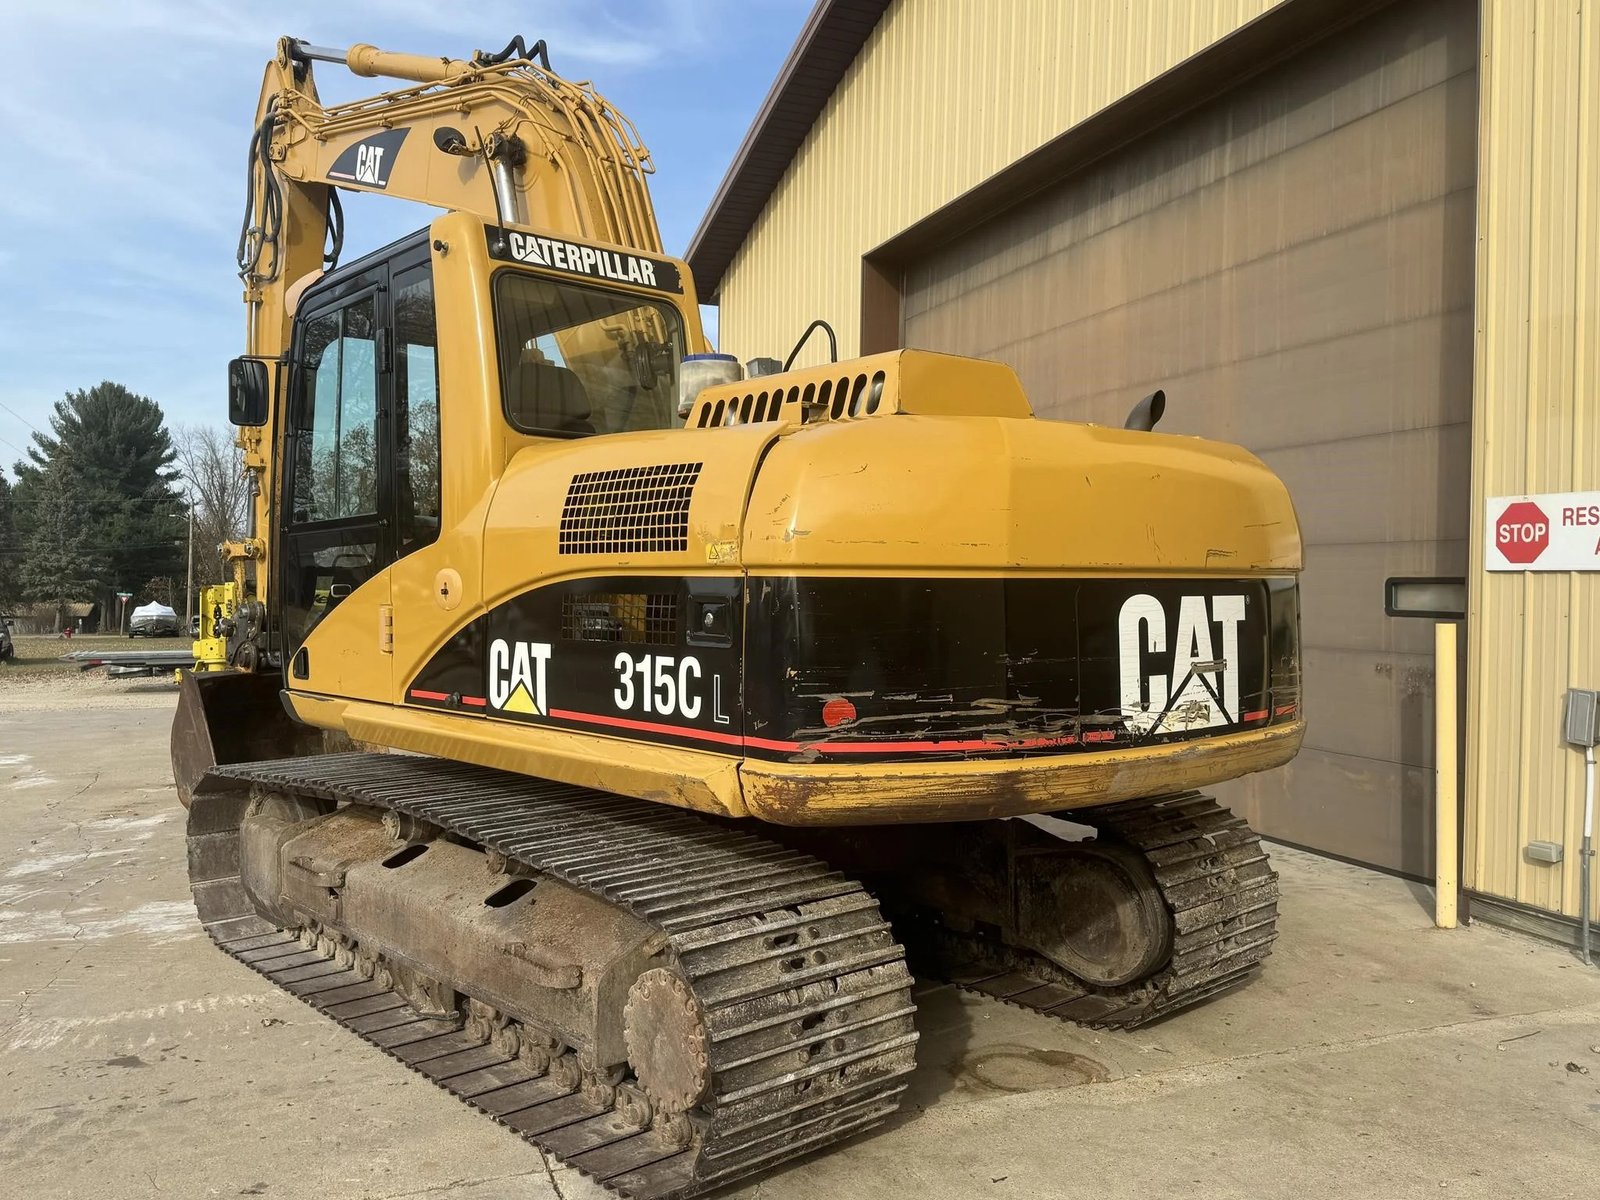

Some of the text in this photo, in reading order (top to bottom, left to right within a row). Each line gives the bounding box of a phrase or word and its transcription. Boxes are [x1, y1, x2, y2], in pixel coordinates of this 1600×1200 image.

[355, 144, 384, 184] CAT
[508, 232, 657, 287] CATERPILLAR
[1499, 523, 1546, 543] STOP
[489, 638, 552, 717] CAT
[614, 652, 730, 725] 315C L
[1118, 593, 1246, 735] CAT
